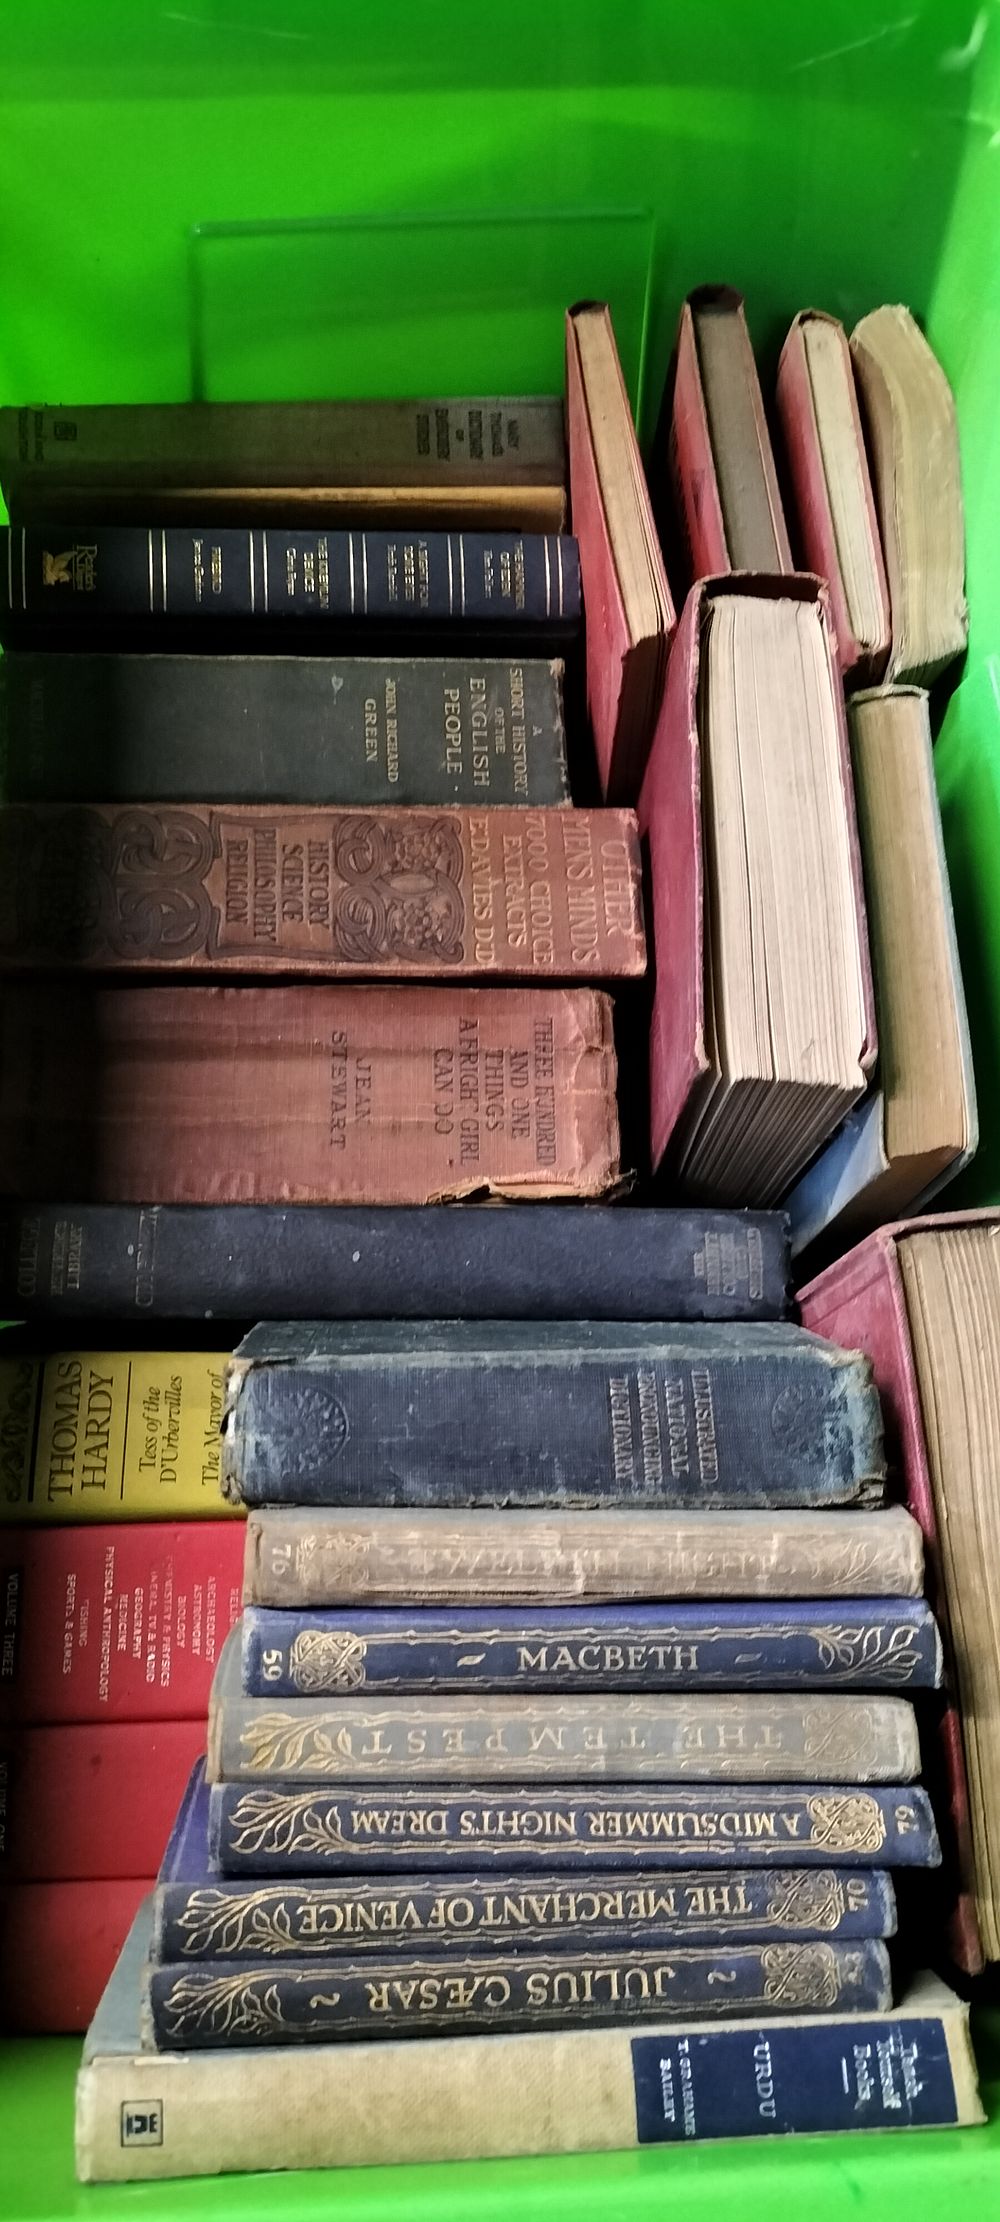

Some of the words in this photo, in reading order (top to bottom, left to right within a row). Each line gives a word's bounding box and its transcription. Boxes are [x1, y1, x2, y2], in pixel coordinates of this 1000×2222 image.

[385, 678, 397, 715] JOHN
[494, 706, 505, 727] OF
[509, 667, 525, 720] SHORT
[364, 698, 378, 763] GREEN
[386, 719, 399, 783] RICHARD
[444, 688, 463, 774] PEOPLE
[470, 677, 490, 786] ENGLISH
[495, 727, 506, 755] THE
[532, 724, 542, 737] A
[511, 725, 529, 796] HISTORY
[523, 814, 548, 871] 7000
[225, 838, 250, 924] RELIGION
[252, 828, 278, 942] PHILOSOPHY
[281, 842, 305, 924] SCIENCE
[306, 839, 332, 930] HISTORY
[501, 834, 528, 948] EXTRACTS
[600, 838, 631, 937] OTHER
[530, 880, 555, 966] CHOICE
[567, 884, 599, 964] MINDS
[459, 1017, 479, 1033] A
[534, 1017, 554, 1079] THREE
[330, 1031, 347, 1150] STEWART
[355, 1057, 371, 1124] JEAN
[433, 1048, 454, 1092] CAN
[484, 1049, 505, 1132] THINGS
[509, 1049, 529, 1089] AND
[460, 1118, 480, 1167] GIRL
[511, 1097, 530, 1140] ONE
[535, 1085, 557, 1167] HUNDRED
[66, 1223, 83, 1291] LIBRARY
[143, 1386, 161, 1412] the
[207, 1369, 225, 1389] of
[48, 1360, 82, 1502] THOMAS
[81, 1370, 114, 1492] HARDY
[142, 1412, 163, 1432] of
[159, 1375, 183, 1483] D'Urbervilles
[203, 1391, 224, 1448] Mayor
[609, 1374, 635, 1483] DICTIONARY
[664, 1377, 690, 1479] NATIONAL
[690, 1368, 719, 1485] ILLUSTRATED
[139, 1437, 158, 1473] Tess
[201, 1451, 220, 1486] The
[103, 1545, 115, 1604] PHYSICAL
[271, 1543, 291, 1575] 76
[4, 1572, 18, 1627] VOLUME
[117, 1593, 128, 1652] MEDICINE
[132, 1586, 144, 1659] GEOGRAPHY
[176, 1594, 187, 1649] BIOLOGY
[191, 1583, 202, 1656] ASTRONOMY
[204, 1575, 217, 1664] ARCHAEOLOGY
[2, 1632, 15, 1677] THREE
[62, 1632, 73, 1674] GAMES
[99, 1606, 112, 1702] ANTHROPOLOGY
[145, 1644, 157, 1683] RADIO
[160, 1636, 171, 1688] PHYSICS
[262, 1649, 284, 1682] 59
[516, 1645, 699, 1672] MACBETH
[361, 1725, 647, 1757] TEMPEST
[681, 1724, 782, 1750] THE
[350, 1809, 449, 1836] DREAM
[459, 1809, 577, 1836] NIGHT'S
[583, 1811, 777, 1838] MIDSUMMER
[778, 1812, 801, 1838] A
[296, 1900, 422, 1935] VENICE
[426, 1897, 474, 1928] OF
[480, 1888, 679, 1927] MERCHANT
[684, 1885, 753, 1917] THE
[364, 1975, 512, 2012] CÆSAR
[525, 1965, 677, 2005] JULIUS
[659, 2058, 676, 2122] BAILEY
[680, 2057, 696, 2136] GRAHAME
[753, 2040, 777, 2118] URDU
[853, 2043, 875, 2098] Books
[876, 2038, 902, 2109] Yourself
[901, 2042, 924, 2099] Teach
